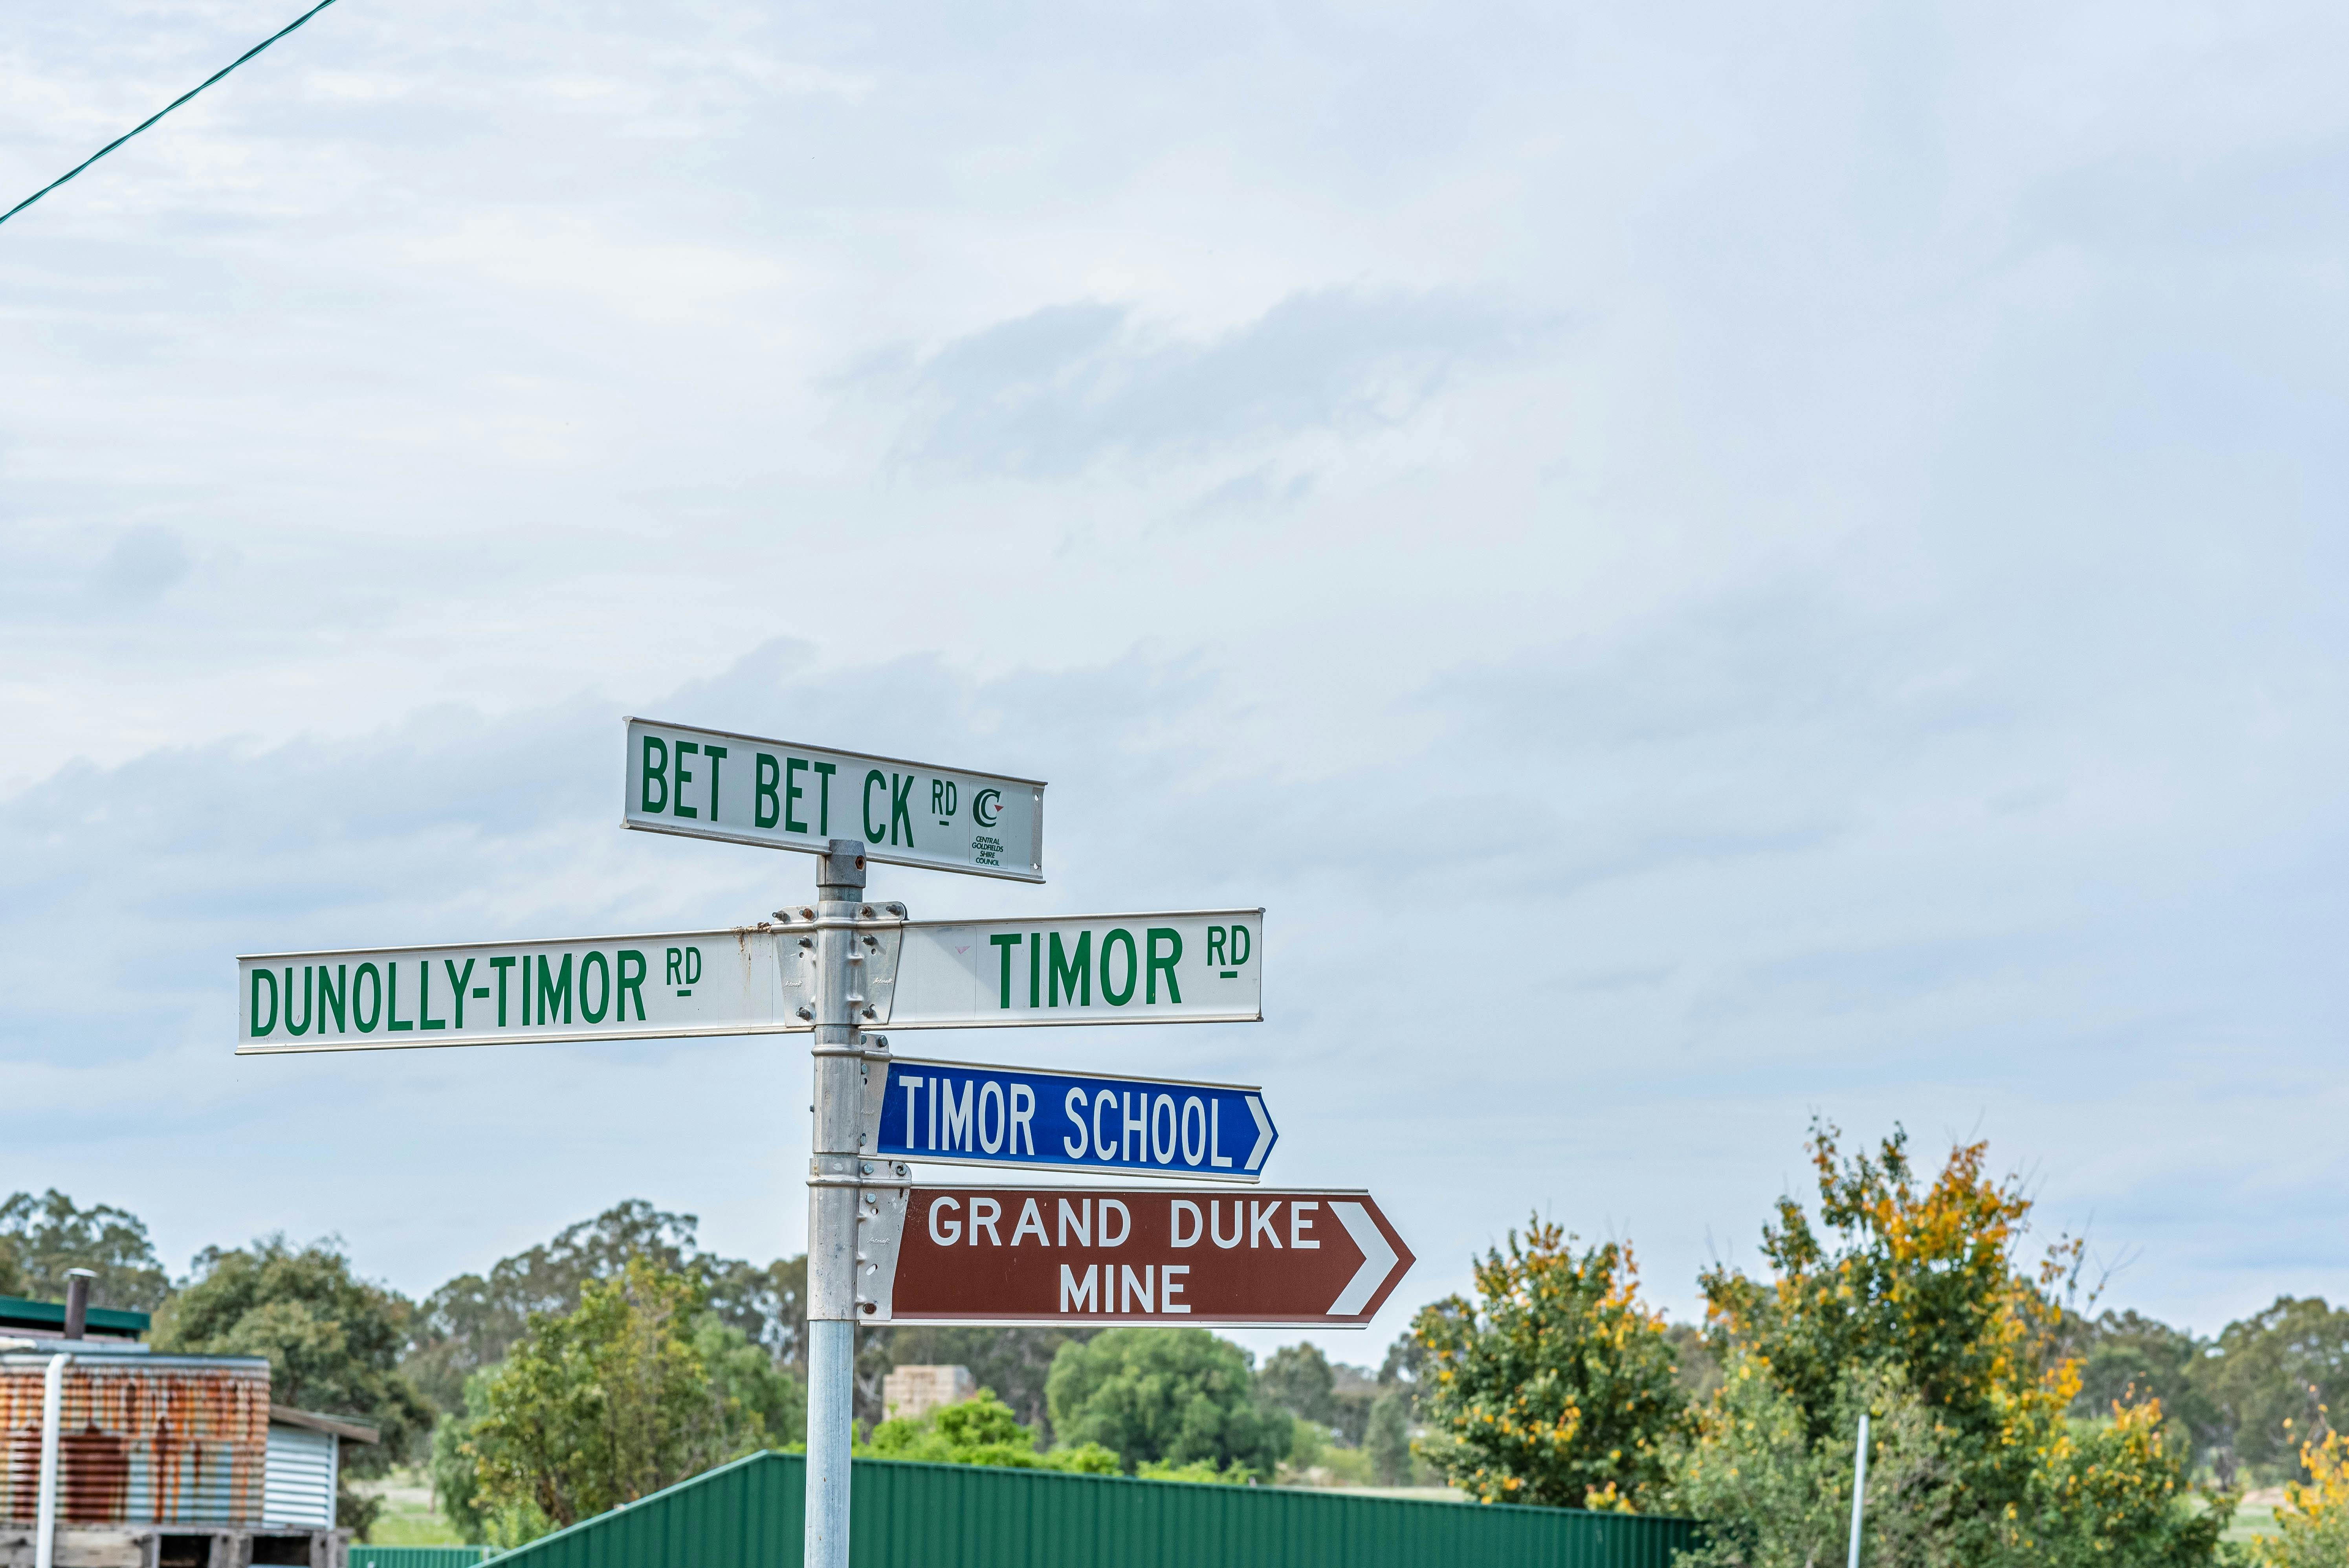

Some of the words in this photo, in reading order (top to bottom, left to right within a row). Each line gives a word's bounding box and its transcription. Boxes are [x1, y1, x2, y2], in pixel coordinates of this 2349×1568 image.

[642, 735, 727, 822] BET
[754, 753, 836, 836] BET
[863, 770, 915, 848] CK
[932, 779, 957, 816] RD
[972, 842, 1004, 853] GOLDFIELDS
[976, 836, 1000, 845] CENTRAL
[976, 857, 1000, 866] COUNCIL
[251, 950, 647, 1037] DUNOLLY-TIMOR
[666, 947, 702, 986] RD
[990, 928, 1183, 1009] TIMOR
[1207, 924, 1251, 966] RD
[899, 1075, 1036, 1155] TIMOR
[1063, 1087, 1233, 1168] SCHOOL
[929, 1196, 1131, 1247] GRAND
[1171, 1199, 1320, 1249] DUKE
[1060, 1264, 1191, 1313] MINE
